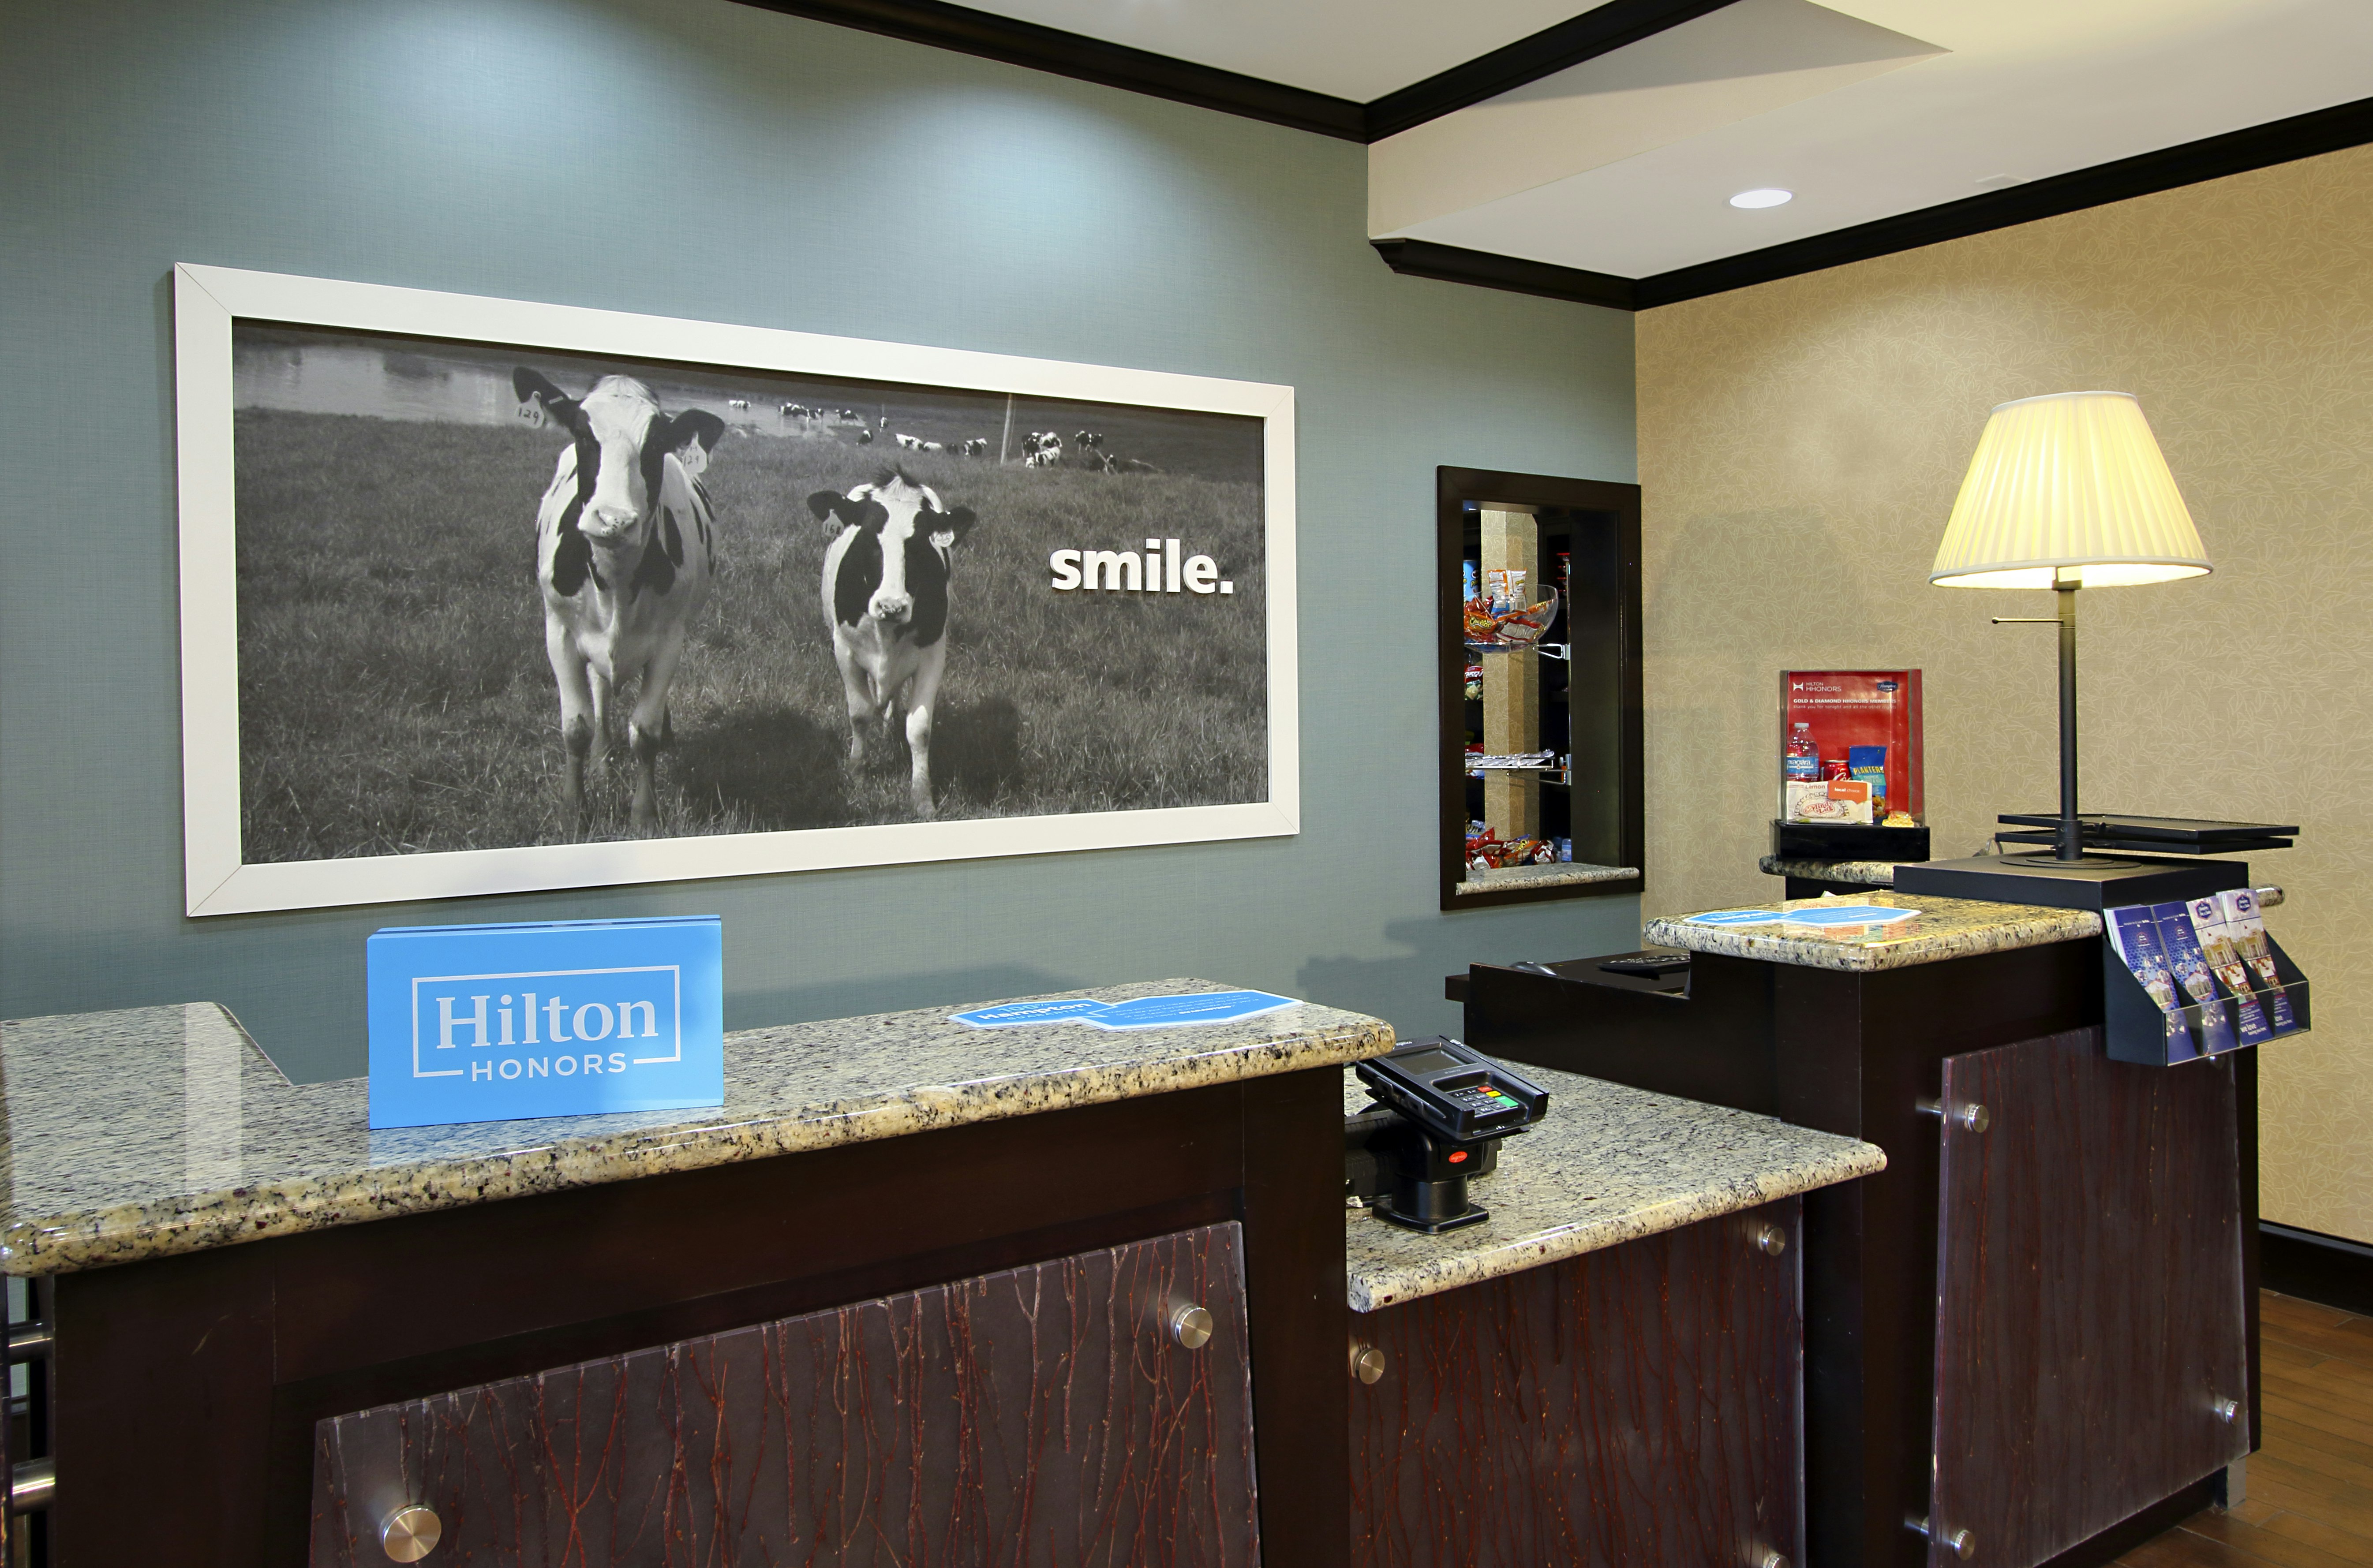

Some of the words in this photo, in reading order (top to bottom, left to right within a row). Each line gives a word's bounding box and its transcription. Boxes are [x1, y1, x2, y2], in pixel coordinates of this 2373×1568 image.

[518, 407, 539, 424] 129
[1050, 538, 1234, 594] smile.
[1469, 617, 1492, 628] Cheetos
[977, 1003, 1092, 1020] Hampton
[997, 1003, 1050, 1012] 100%
[436, 993, 659, 1049] Hilton
[472, 1052, 626, 1082] HONORS
